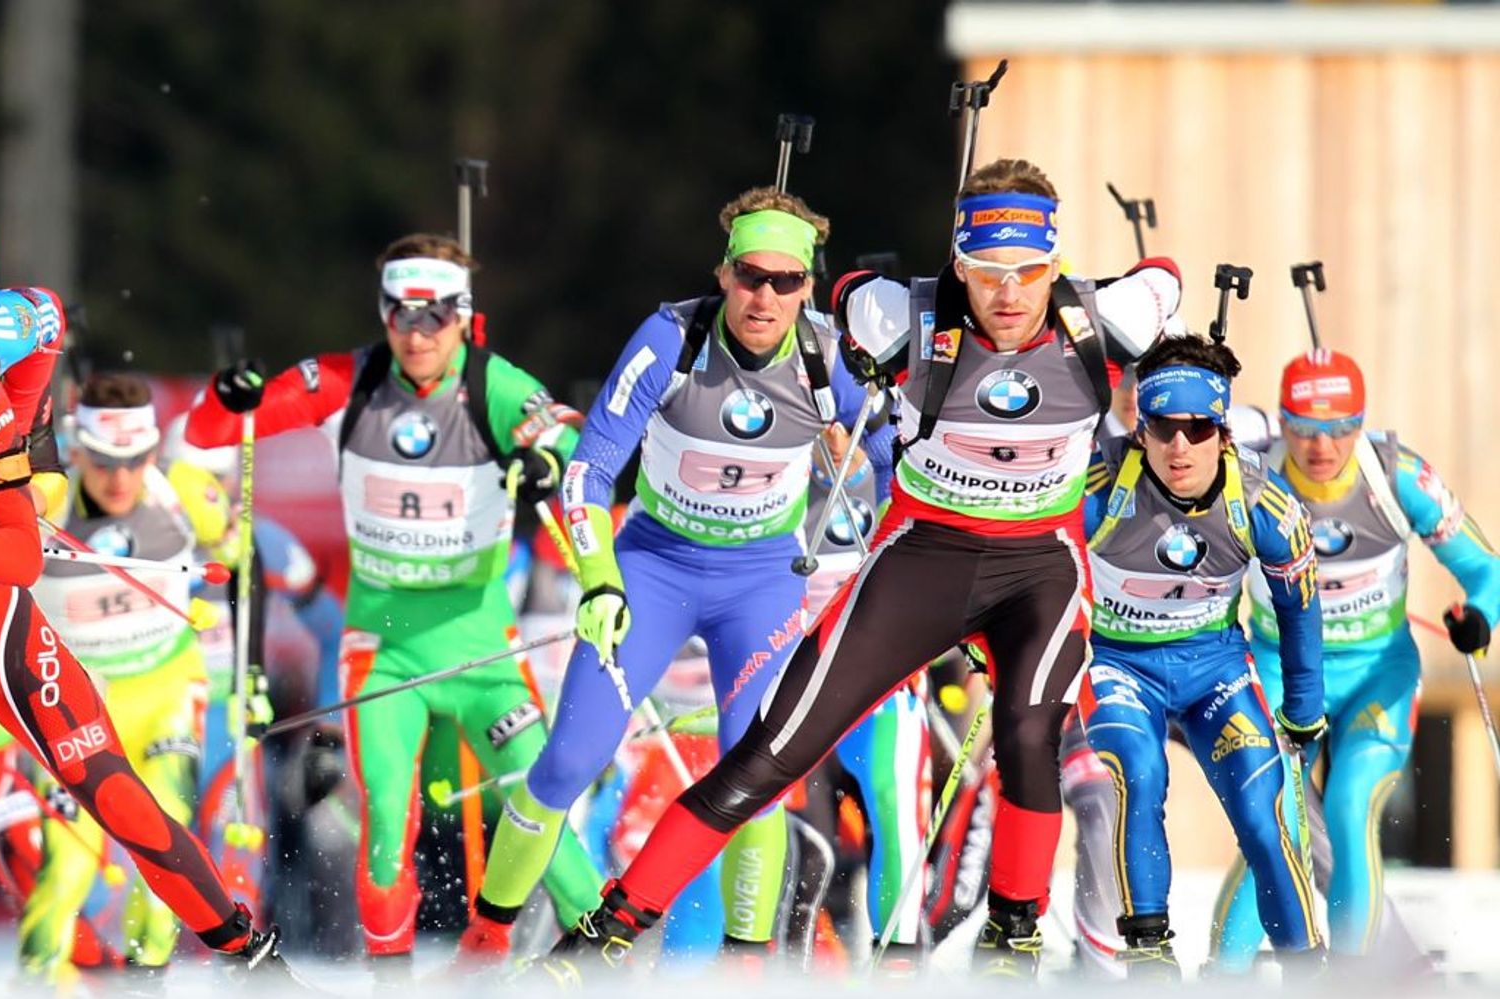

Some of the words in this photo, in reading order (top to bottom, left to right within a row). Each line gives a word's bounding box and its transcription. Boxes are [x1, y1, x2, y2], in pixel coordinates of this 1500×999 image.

[719, 464, 745, 489] 9
[401, 493, 420, 519] 8
[443, 501, 453, 517] 1
[663, 482, 789, 518] RUHPOLDING
[355, 522, 474, 548] RUHPOLDING
[655, 501, 765, 539] ERDGAS
[354, 551, 452, 581] ERDGAS
[99, 594, 131, 615] 15
[37, 626, 60, 707] odlo
[57, 724, 107, 762] DNB
[1211, 734, 1271, 762] adidas
[732, 848, 763, 937] LOVENIA
